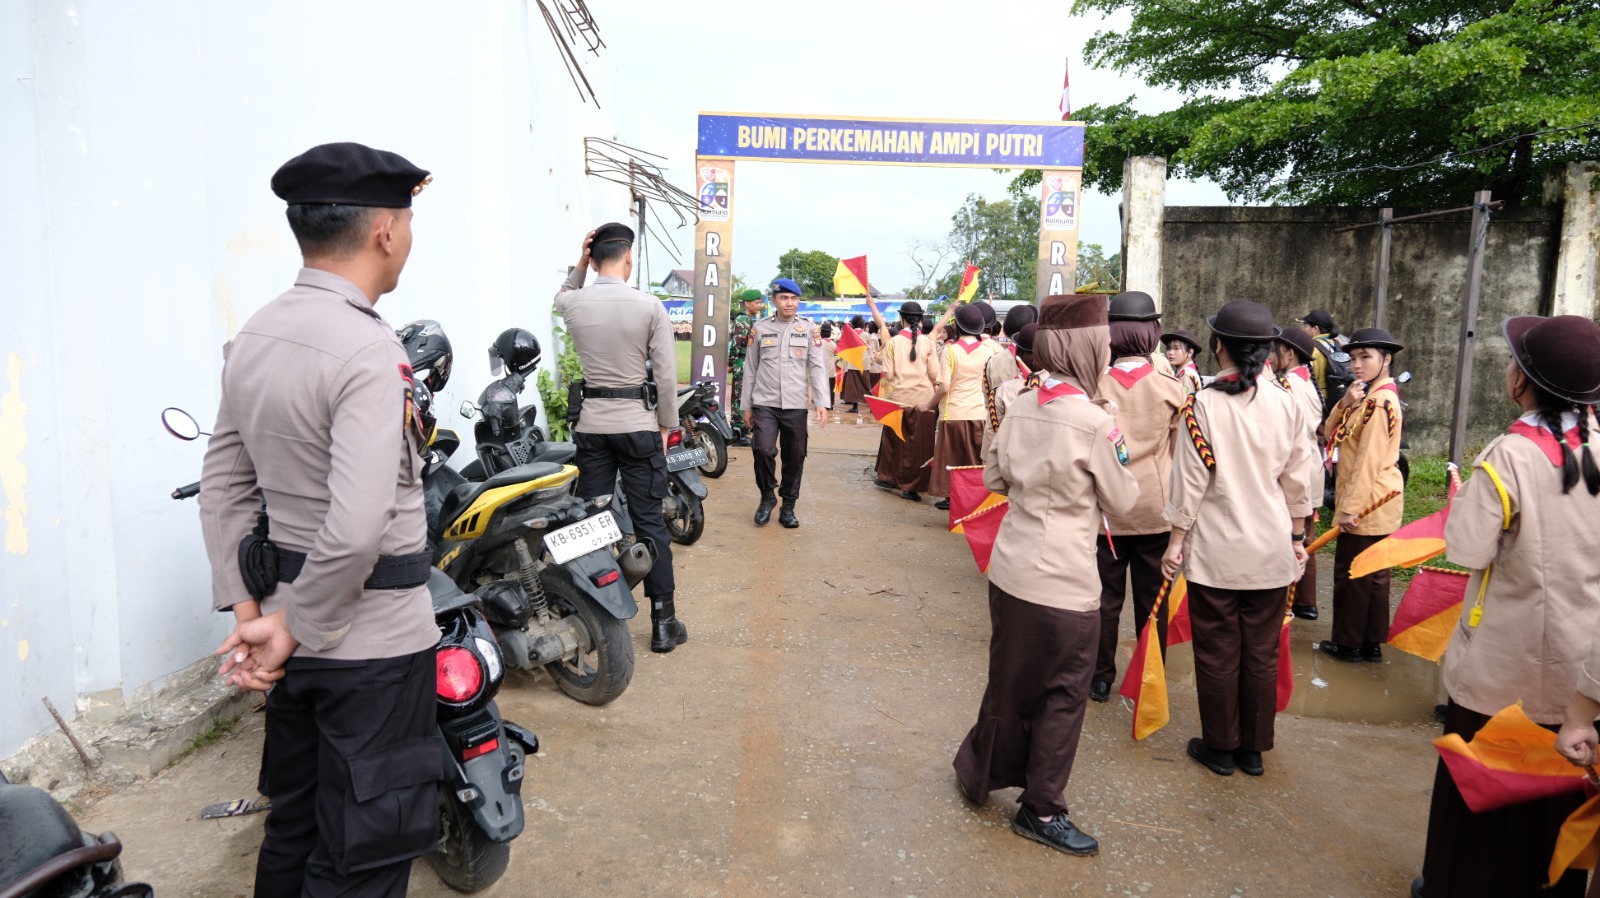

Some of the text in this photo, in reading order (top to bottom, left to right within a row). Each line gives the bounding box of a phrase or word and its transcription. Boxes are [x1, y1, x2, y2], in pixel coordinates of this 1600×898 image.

[737, 125, 1043, 157] BUMI PERKEMAHAN AMPI PUTRI
[701, 231, 720, 377] RAIDA
[550, 514, 614, 547] KB 6951 ER
